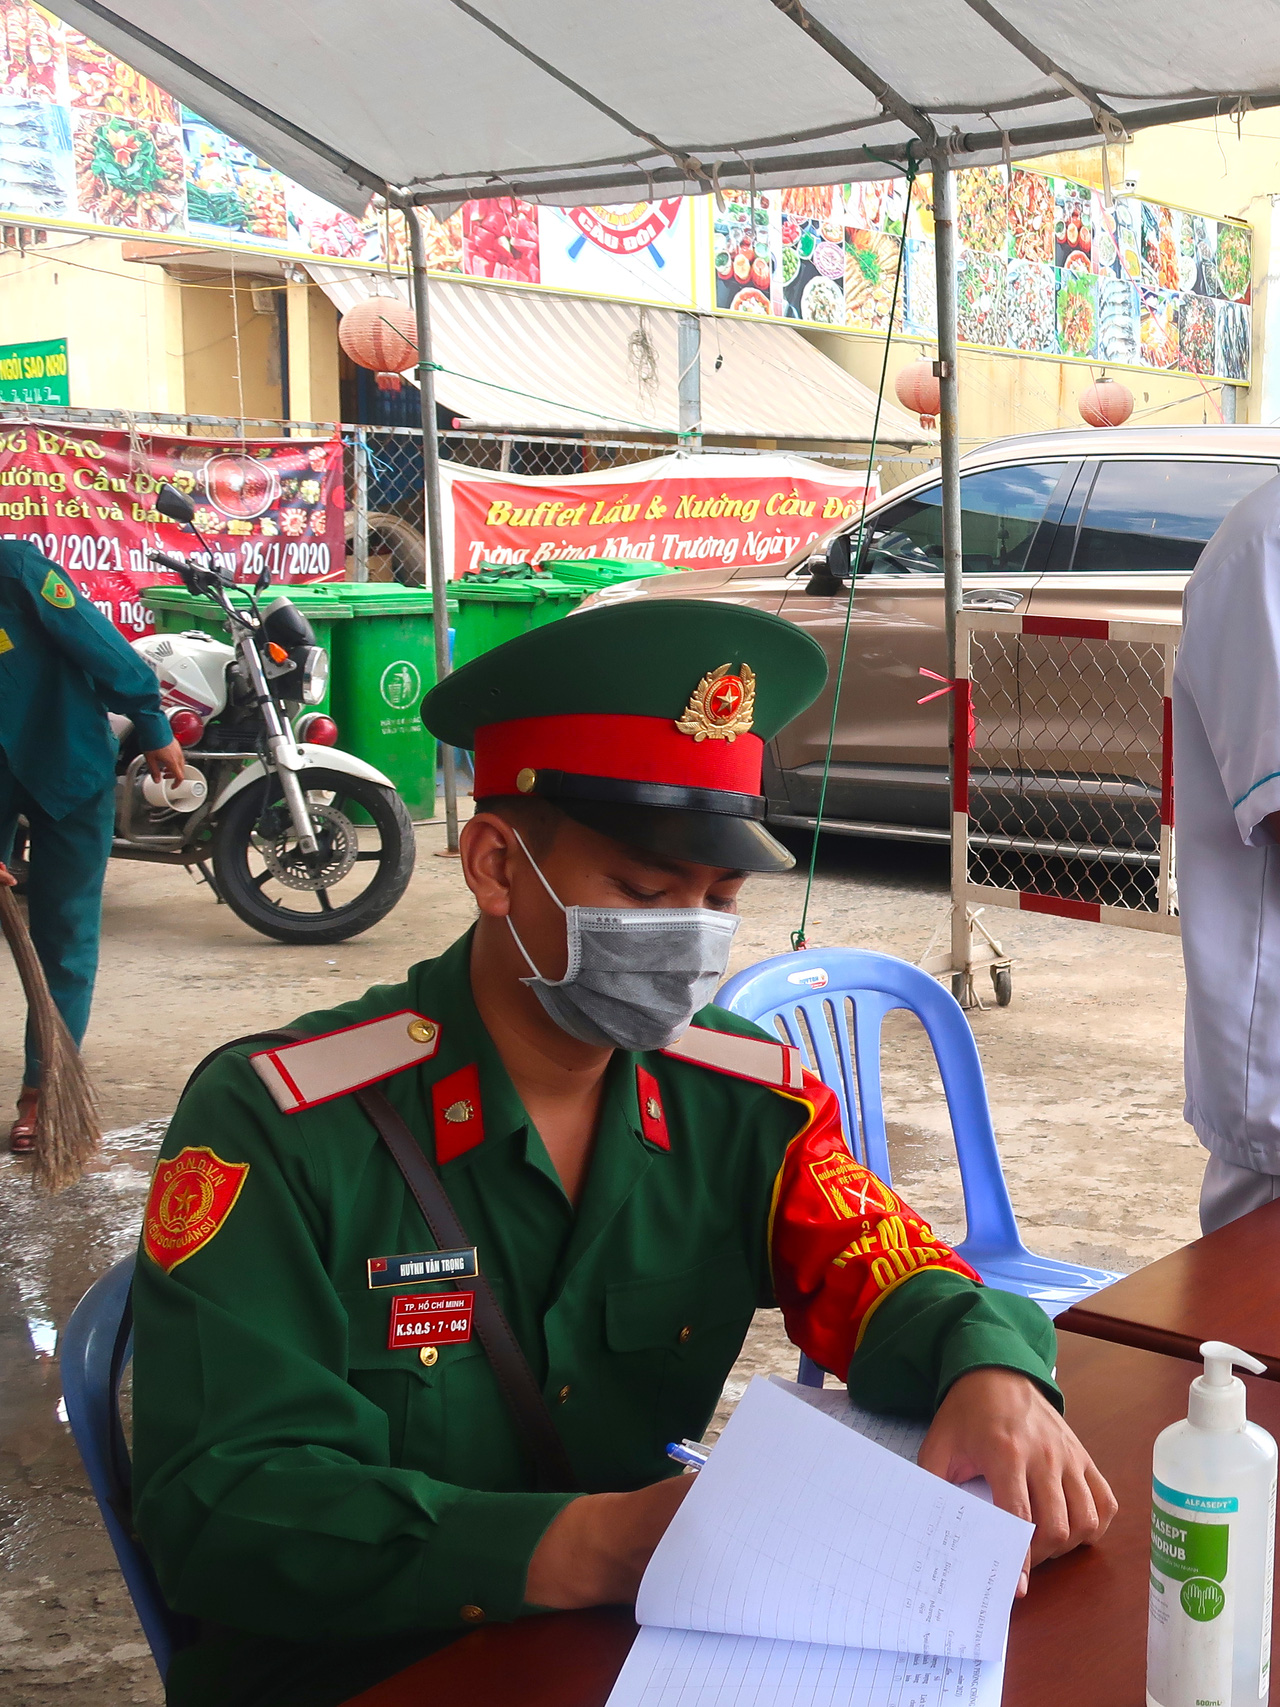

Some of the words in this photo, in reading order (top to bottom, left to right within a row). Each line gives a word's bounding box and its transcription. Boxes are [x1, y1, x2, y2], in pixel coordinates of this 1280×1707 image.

[37, 430, 107, 459] BÁO
[72, 466, 129, 493] Cầu
[54, 495, 92, 519] tết
[96, 502, 125, 521] và
[486, 500, 587, 527] Buffet
[587, 493, 642, 526] Lẩu
[645, 494, 668, 520] &
[674, 493, 761, 523] Nướng
[765, 488, 818, 518] Cầu
[241, 541, 331, 577] 26/1/2020
[661, 533, 740, 565] Trương
[741, 528, 802, 564] Ngày
[400, 1260, 425, 1277] HUỲNH
[425, 1258, 440, 1274] VĂN
[440, 1257, 465, 1274] TRỌNG
[404, 1303, 417, 1312] TP.
[431, 1299, 445, 1310] CHÍ
[445, 1299, 465, 1309] MINH
